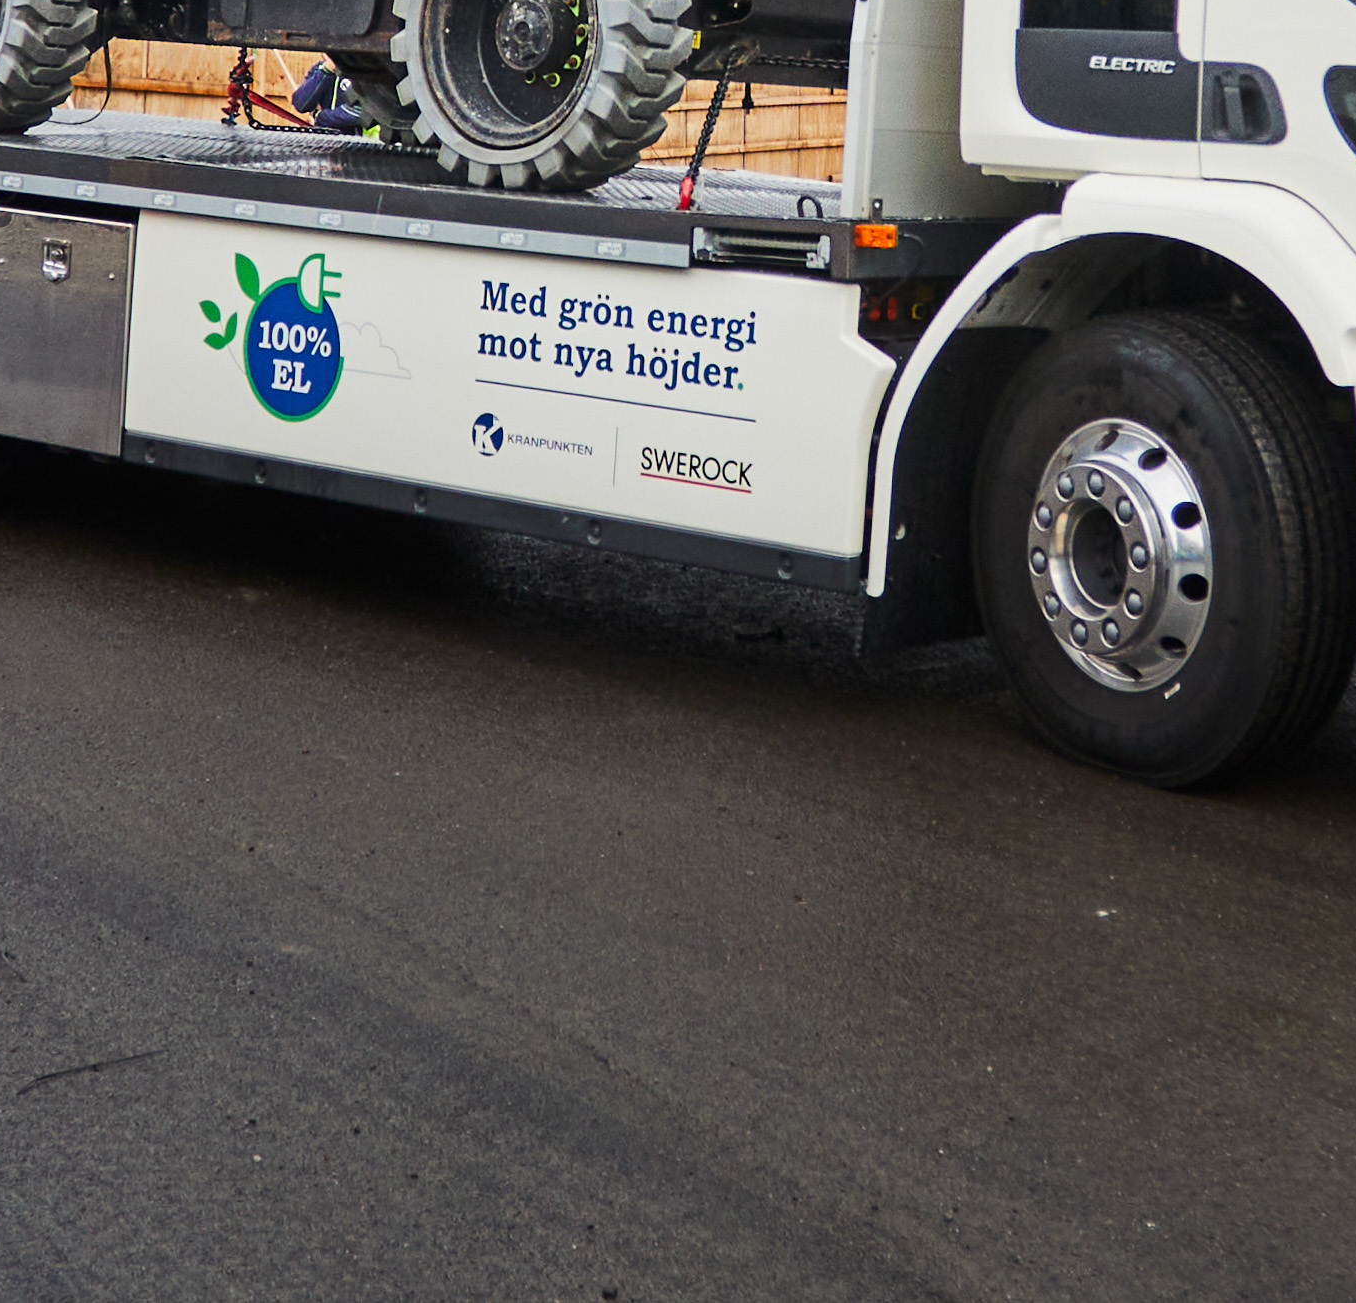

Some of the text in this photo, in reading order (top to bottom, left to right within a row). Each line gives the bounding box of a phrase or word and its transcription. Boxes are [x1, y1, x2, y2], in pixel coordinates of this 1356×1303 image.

[1089, 55, 1176, 74] ELECTRIC
[480, 280, 757, 352] Med grön energi
[258, 320, 332, 358] 100%
[271, 358, 312, 394] EL
[477, 332, 744, 391] mot nya höjder.
[506, 433, 593, 456] KRANPUNKTEN
[640, 446, 753, 487] SWEROCK
